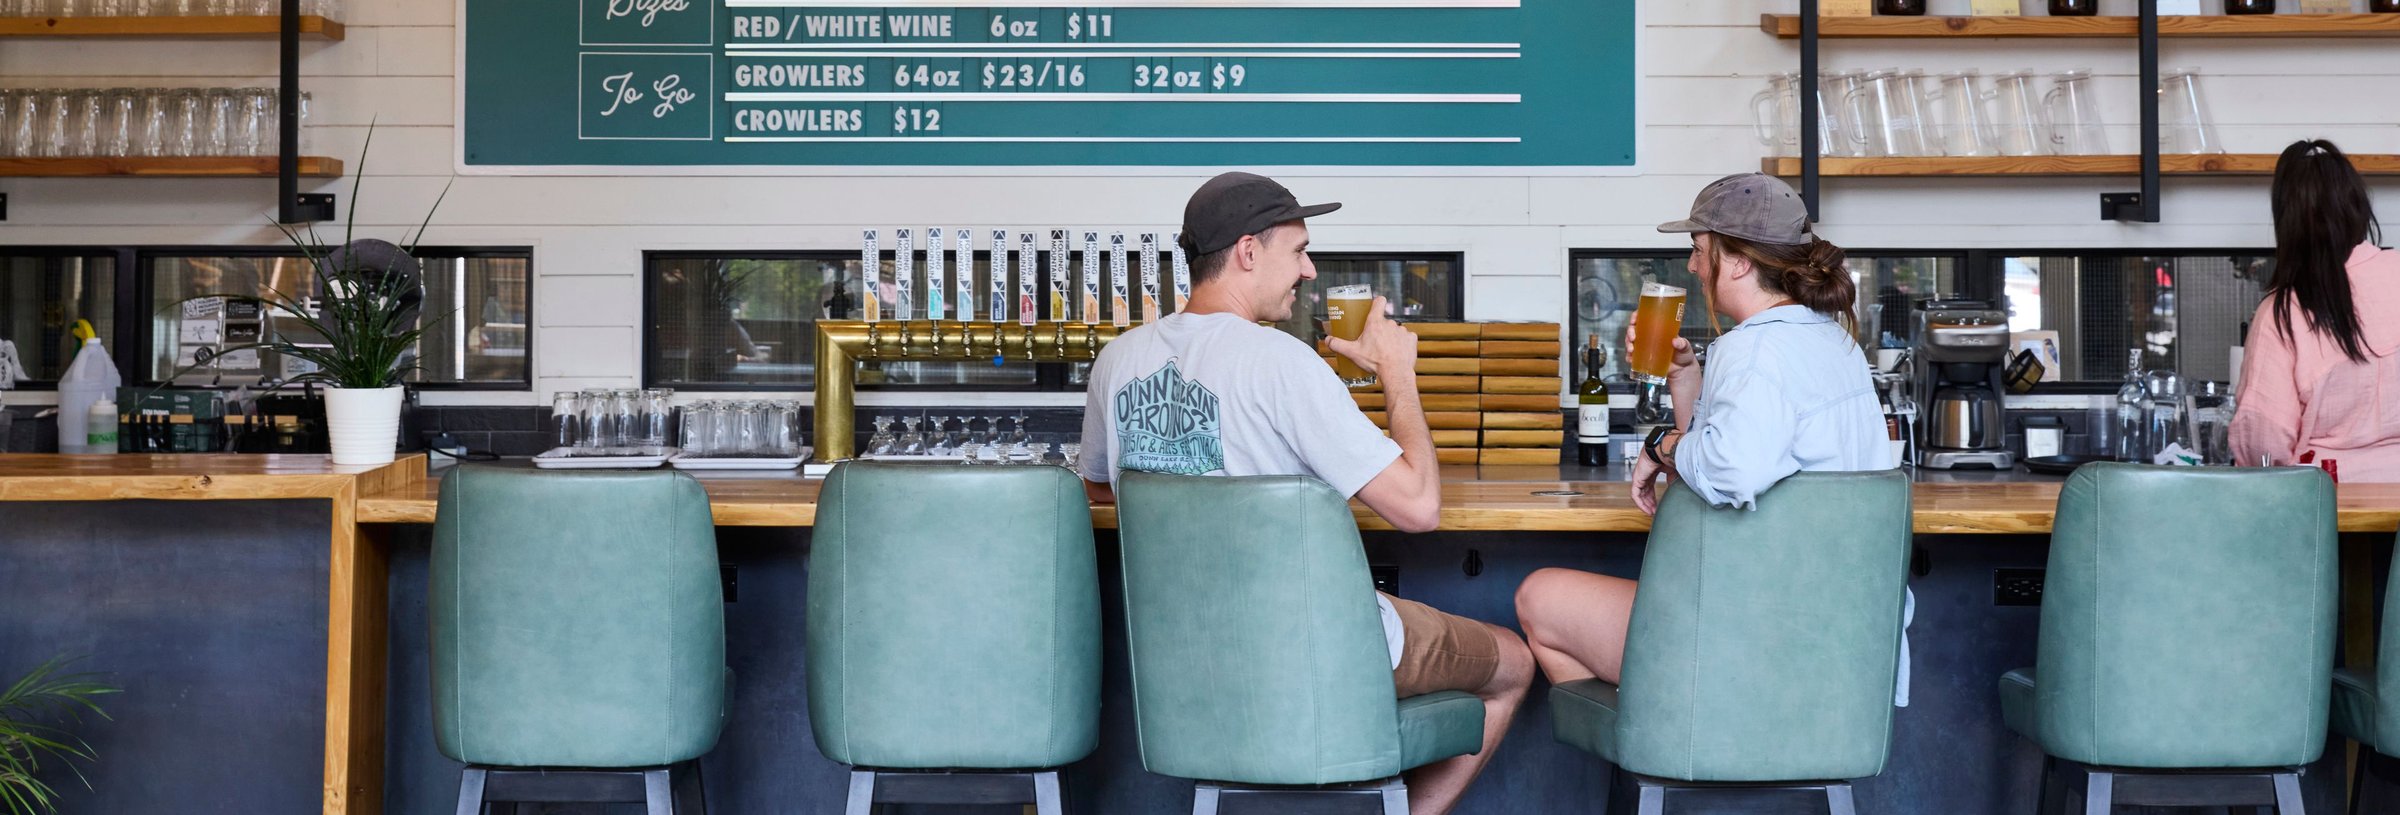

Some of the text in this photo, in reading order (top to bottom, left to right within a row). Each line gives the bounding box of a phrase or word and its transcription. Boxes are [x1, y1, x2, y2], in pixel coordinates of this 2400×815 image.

[734, 16, 780, 38] RED
[805, 15, 881, 37] WHITE
[888, 15, 952, 37] WINE
[1068, 12, 1112, 40] $11
[735, 64, 865, 87] GROWLERS
[983, 61, 1085, 89] $23/16
[1212, 62, 1246, 90] $9
[601, 71, 696, 118] To Go
[735, 106, 940, 134] CROWLERS $12
[1111, 245, 1119, 286] MOUNTAIN
[1118, 244, 1126, 277] FOLDING
[1140, 244, 1148, 285] MOUNTAIN
[1117, 368, 1170, 423] DUNN
[1147, 438, 1157, 453] &
